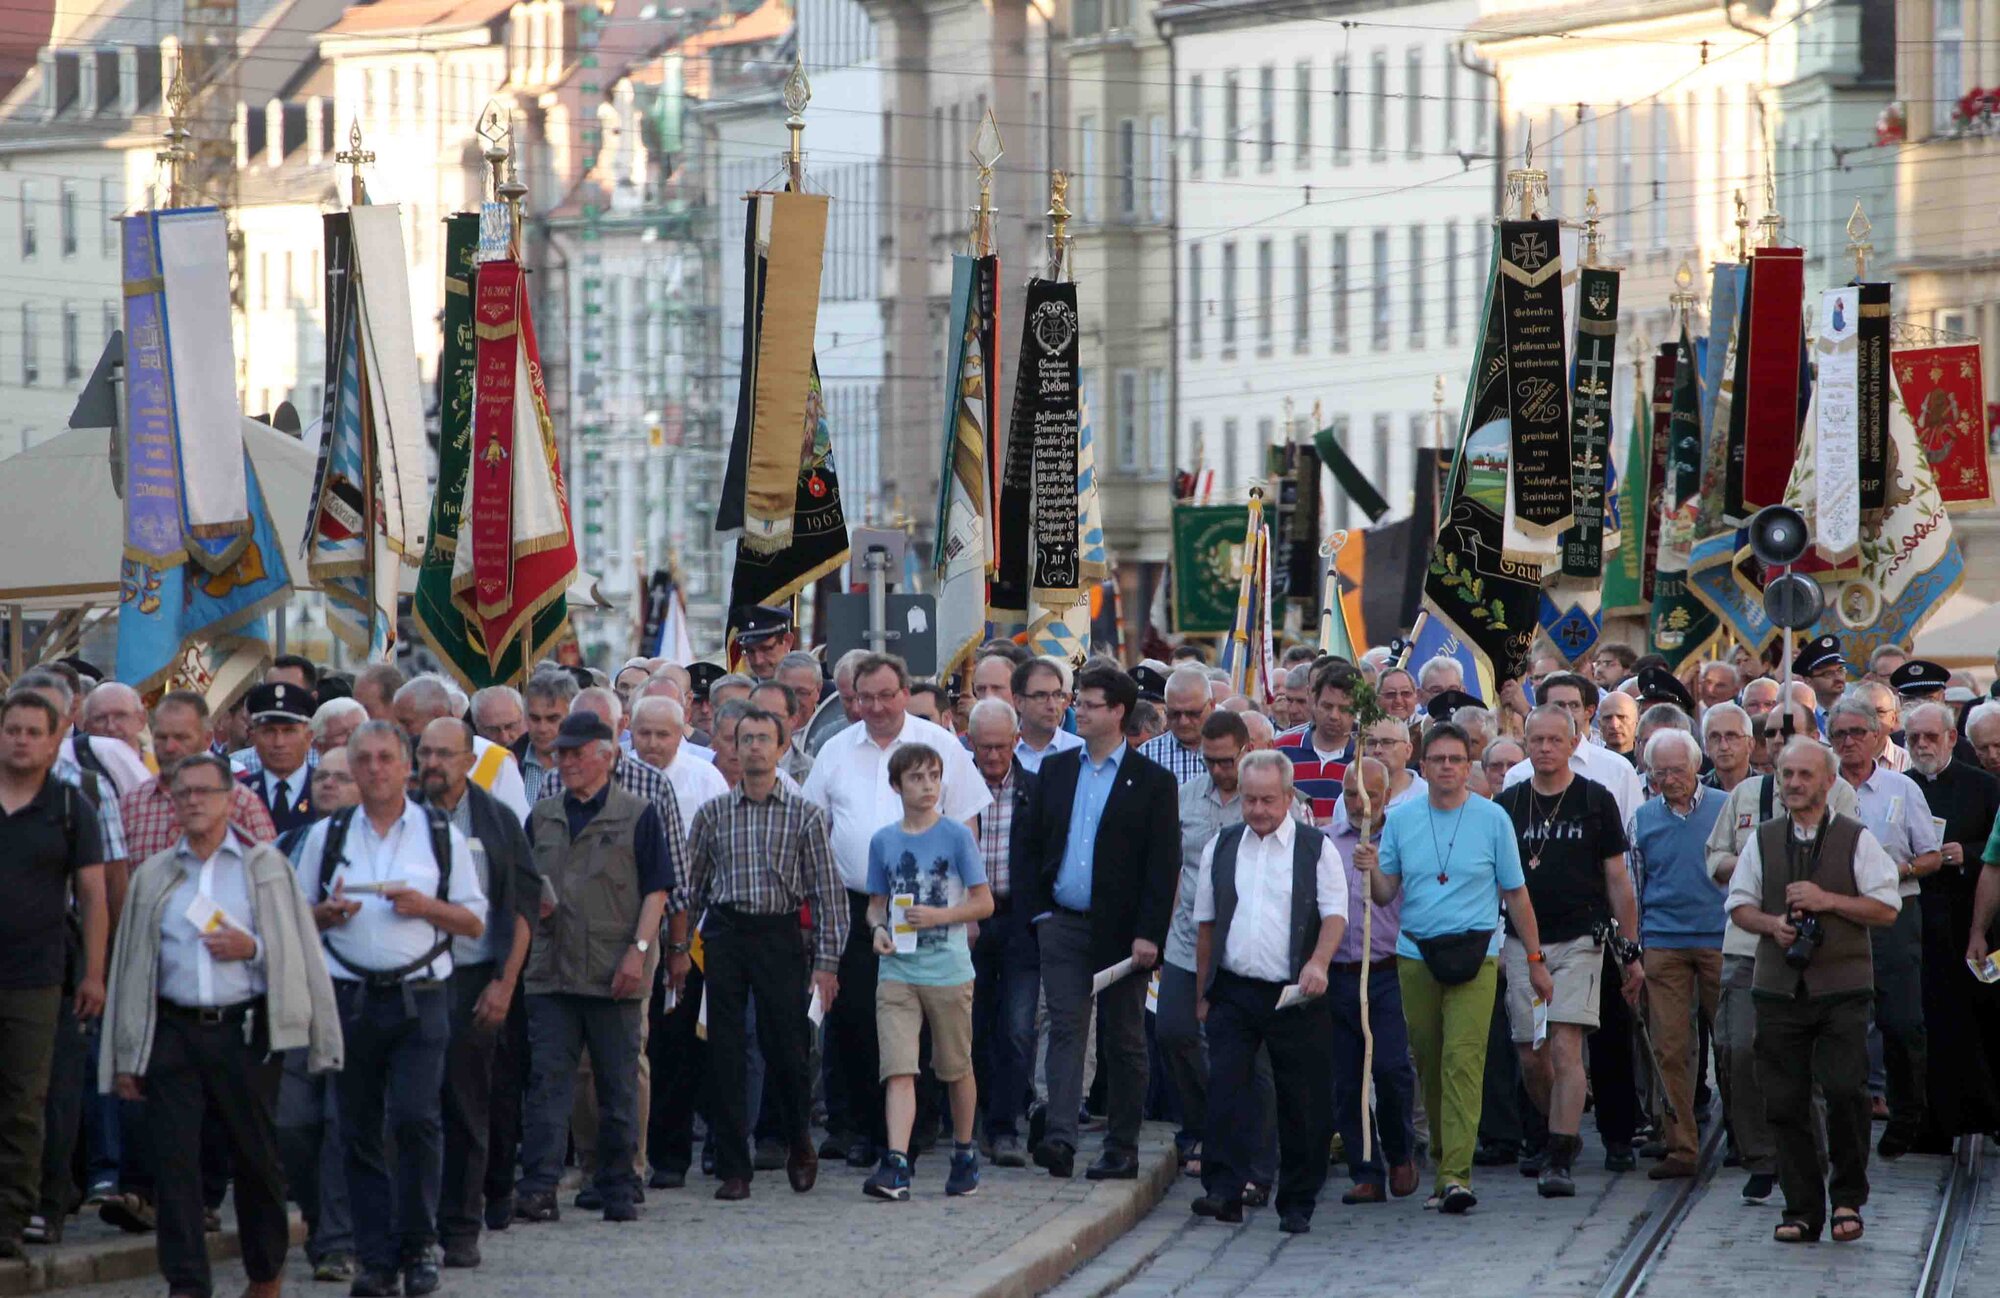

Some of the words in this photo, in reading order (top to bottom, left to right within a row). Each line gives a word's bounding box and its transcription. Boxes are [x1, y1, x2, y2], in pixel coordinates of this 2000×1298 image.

[1524, 290, 1542, 301] Zum
[1513, 307, 1553, 318] Gedenken
[1547, 341, 1561, 350] und
[1039, 379, 1070, 395] Helden
[1521, 431, 1559, 443] gewidmet
[1533, 450, 1549, 458] von
